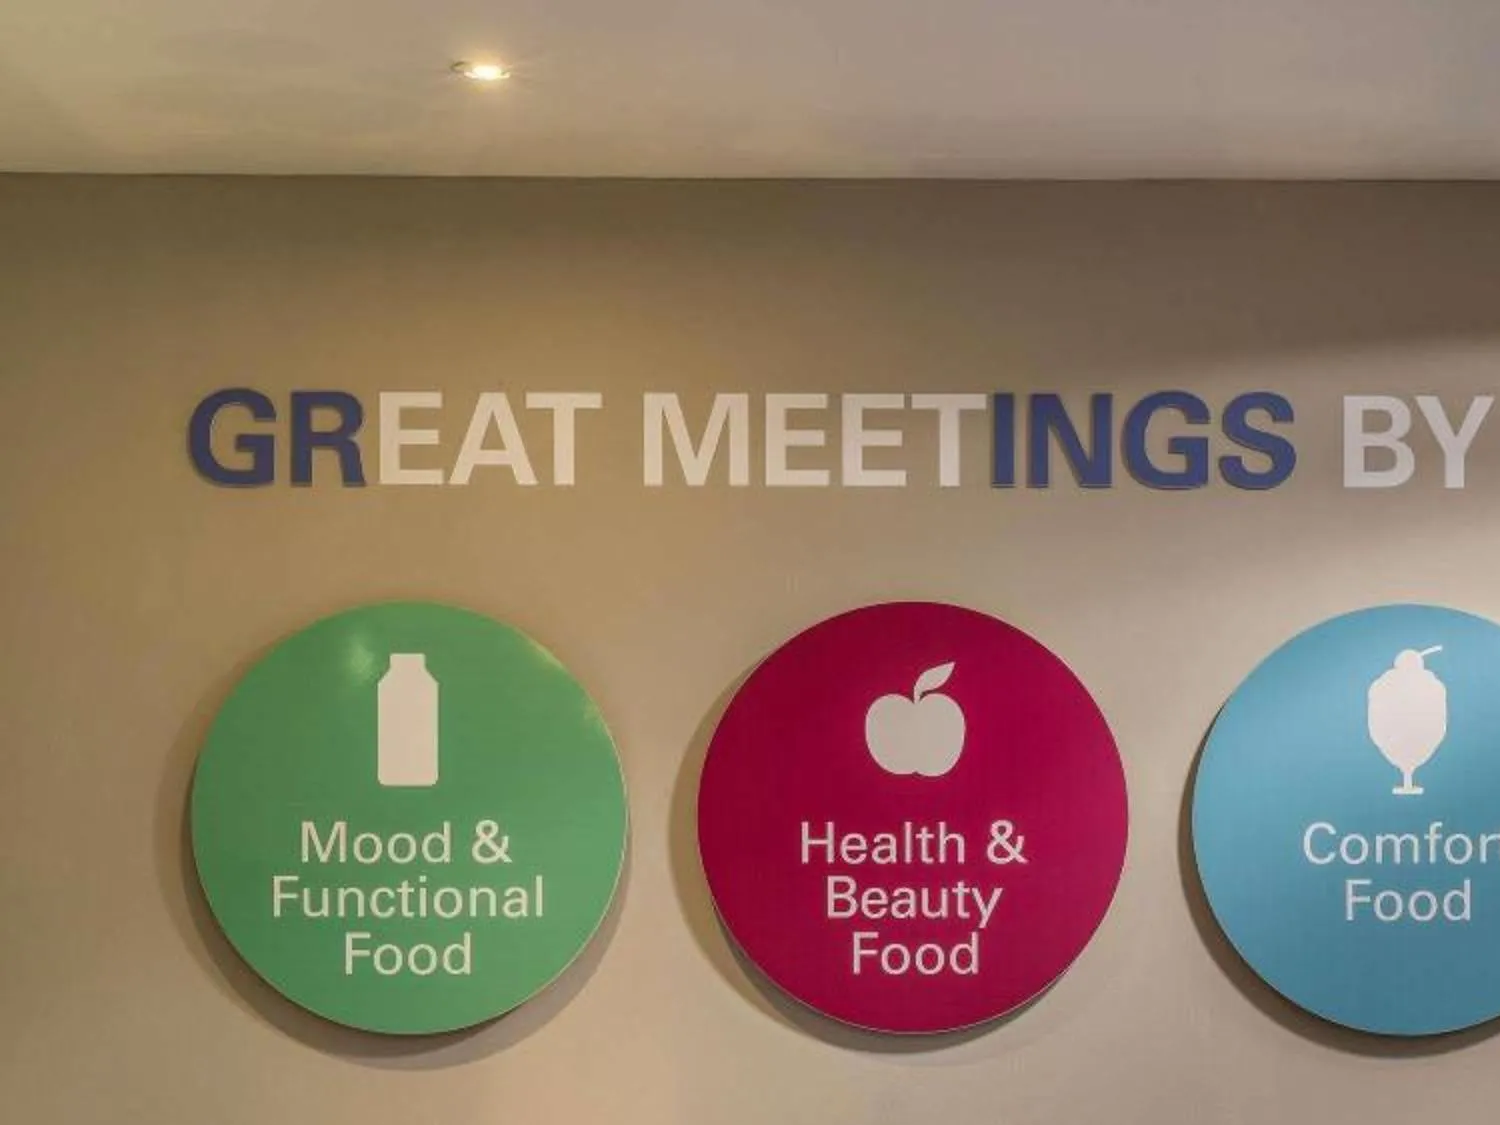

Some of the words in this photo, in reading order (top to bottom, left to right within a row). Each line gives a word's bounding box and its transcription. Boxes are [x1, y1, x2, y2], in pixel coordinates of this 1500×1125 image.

[187, 388, 603, 488] GREAT
[643, 390, 1297, 490] MEETINGS
[1343, 395, 1495, 489] BY
[300, 820, 451, 864] Mood
[471, 819, 513, 864] &
[801, 820, 965, 865] Health
[986, 819, 1029, 865] &
[273, 874, 544, 919] Functional
[826, 875, 1004, 929] Beauty
[1344, 878, 1473, 922] Food
[345, 931, 472, 976] Food
[851, 931, 979, 976] Food
